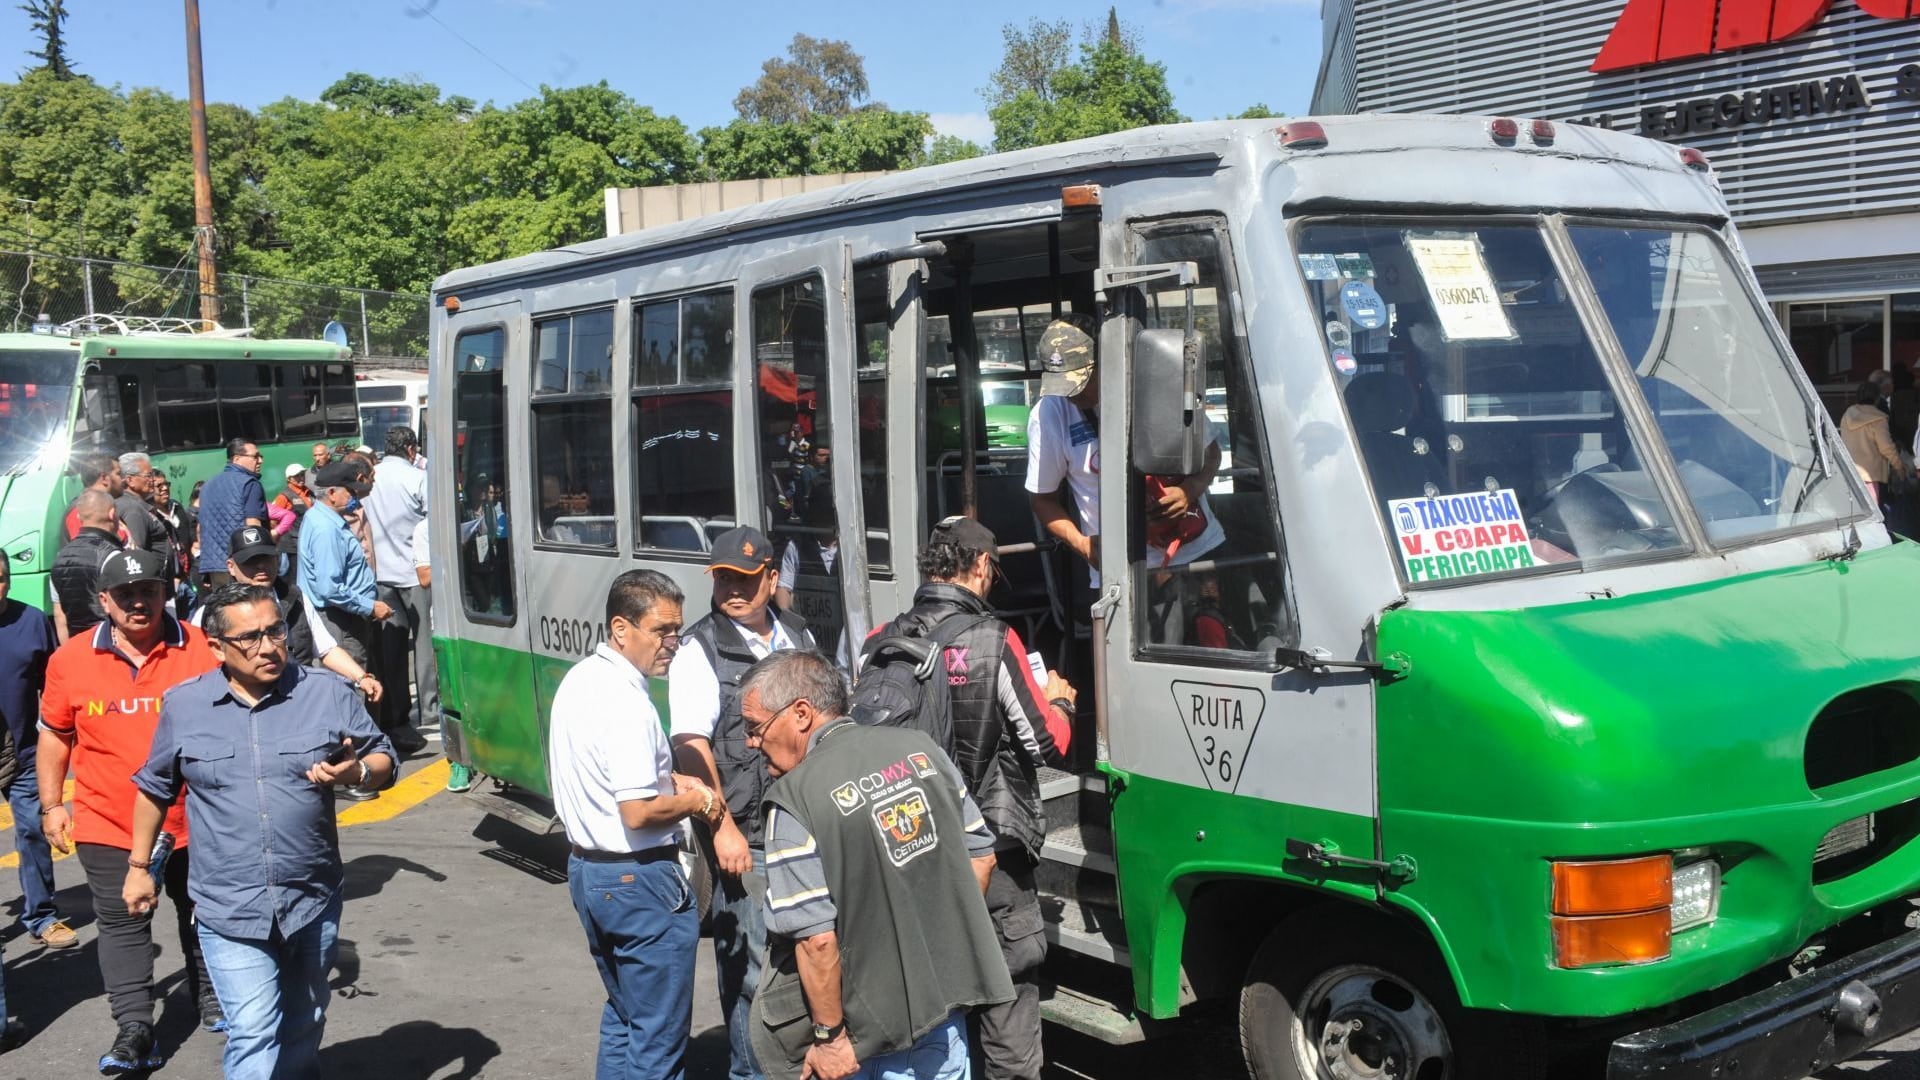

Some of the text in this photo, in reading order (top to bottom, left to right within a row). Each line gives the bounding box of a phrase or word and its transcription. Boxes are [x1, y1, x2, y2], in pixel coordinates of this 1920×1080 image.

[1641, 74, 1872, 138] EJECUTIVA
[1414, 491, 1520, 530] TAXQUEÑA
[1401, 523, 1528, 556] V. COAPA
[1407, 544, 1535, 583] PERICOAPA
[1191, 694, 1244, 730] RUTA
[859, 760, 912, 792] CDMX
[894, 832, 934, 859] CETRAM
